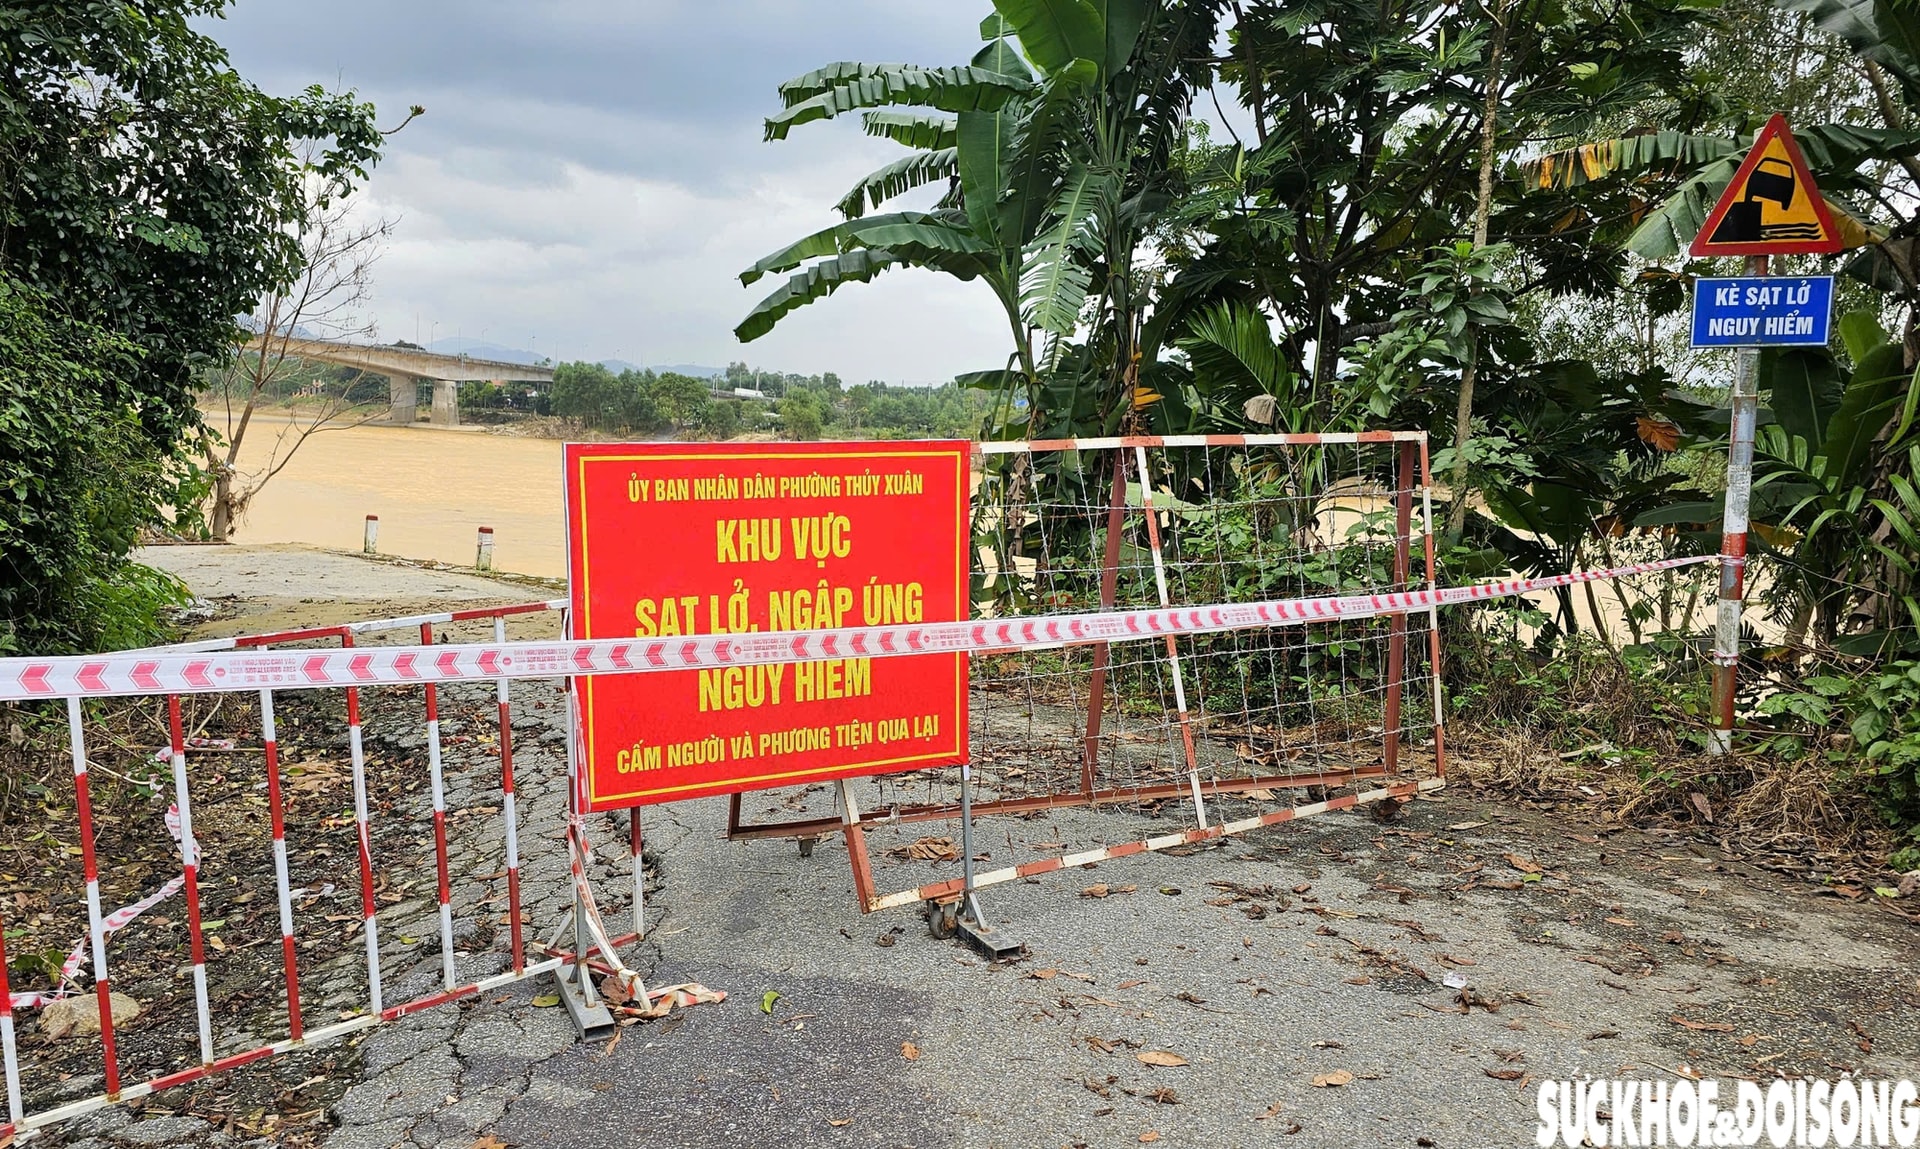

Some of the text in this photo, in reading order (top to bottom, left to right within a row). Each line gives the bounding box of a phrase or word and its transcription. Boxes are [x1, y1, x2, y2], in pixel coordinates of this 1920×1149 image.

[1715, 279, 1812, 311] KÈ SẠT LỞ
[1708, 309, 1814, 337] NGUY HIỂM
[628, 468, 923, 503] ỦY BAN NHÂN DÂN PHƯỜNG THỦY XUÂN
[716, 511, 852, 569] KHU VỰC
[863, 575, 923, 626] ÚNG
[698, 662, 785, 713] NGUY
[617, 714, 939, 774] CẤM NGƯỜI VÀ PHƯƠNG TIỆN QUA LẠI
